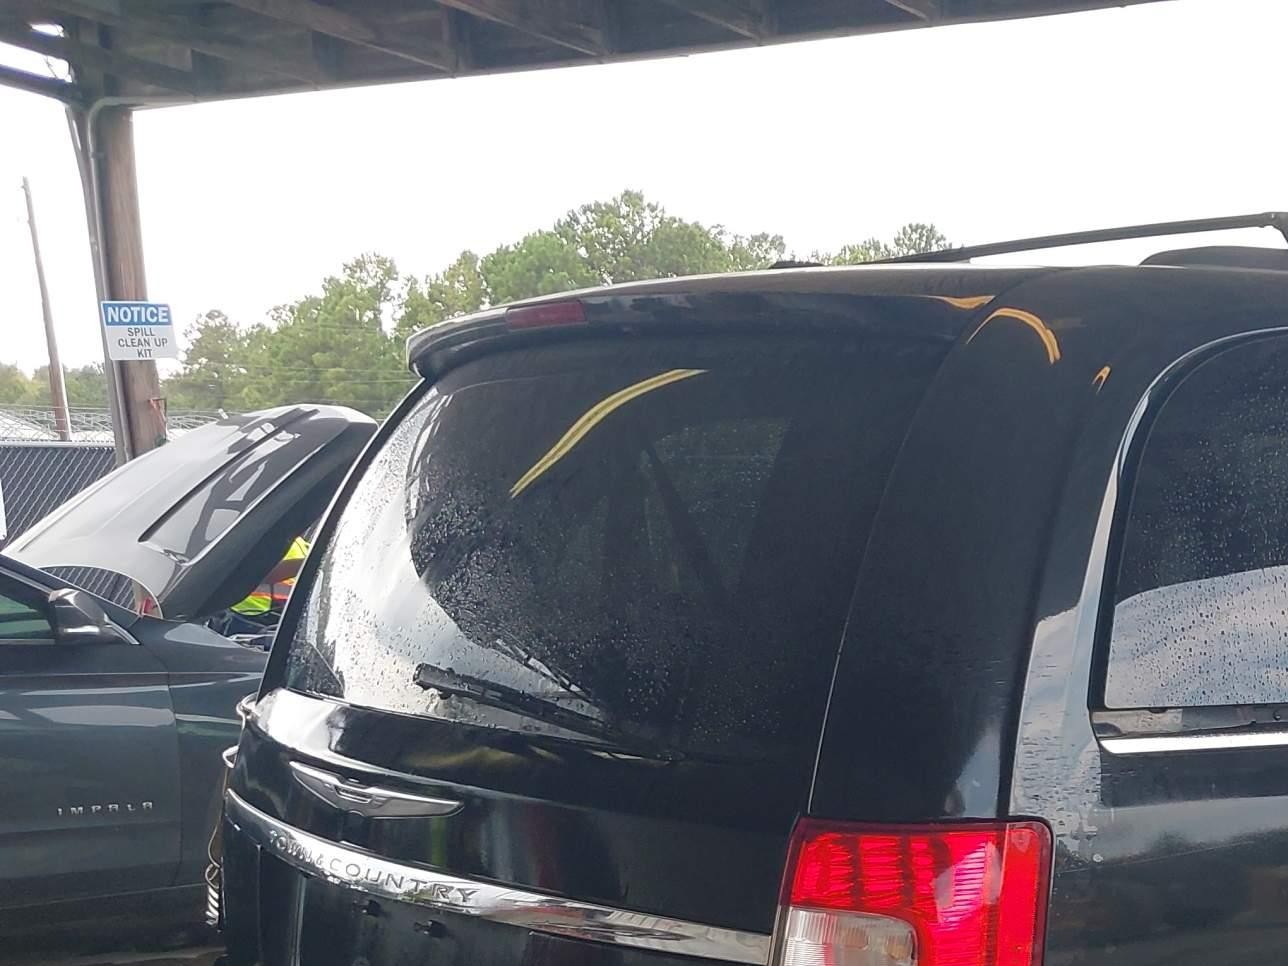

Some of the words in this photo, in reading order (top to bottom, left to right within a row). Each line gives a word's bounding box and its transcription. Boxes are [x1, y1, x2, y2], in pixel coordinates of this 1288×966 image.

[107, 306, 169, 323] NOTICE
[127, 327, 156, 337] SPILL
[118, 338, 151, 348] CLEAN
[153, 338, 168, 347] UP
[137, 349, 153, 358] KIT
[57, 801, 153, 816] IMPALA
[328, 857, 481, 904] COUNTRY
